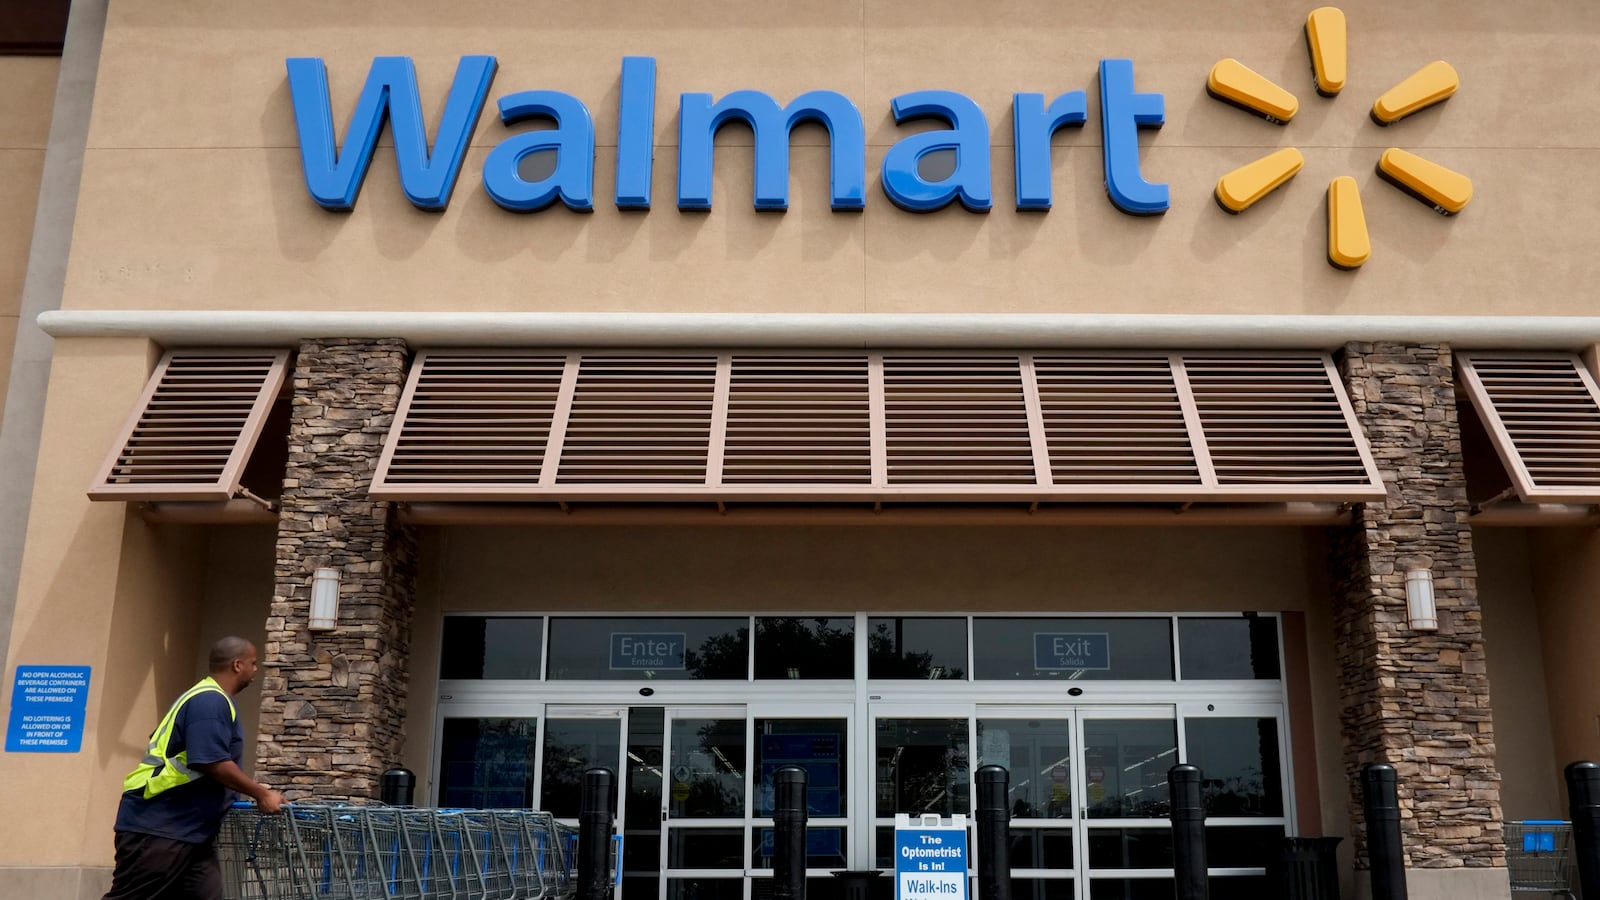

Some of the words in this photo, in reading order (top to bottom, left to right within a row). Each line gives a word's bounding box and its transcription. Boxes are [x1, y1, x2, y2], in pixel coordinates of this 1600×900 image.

[286, 55, 1170, 214] Walmart
[621, 637, 677, 656] Enter
[1053, 637, 1091, 656] Exit
[632, 658, 664, 666] Entrada
[1060, 657, 1084, 666] Salida
[920, 835, 942, 844] The
[902, 846, 962, 860] Optometrist
[919, 862, 928, 870] Is
[932, 862, 945, 870] In!
[907, 880, 957, 894] Walk-Ins
